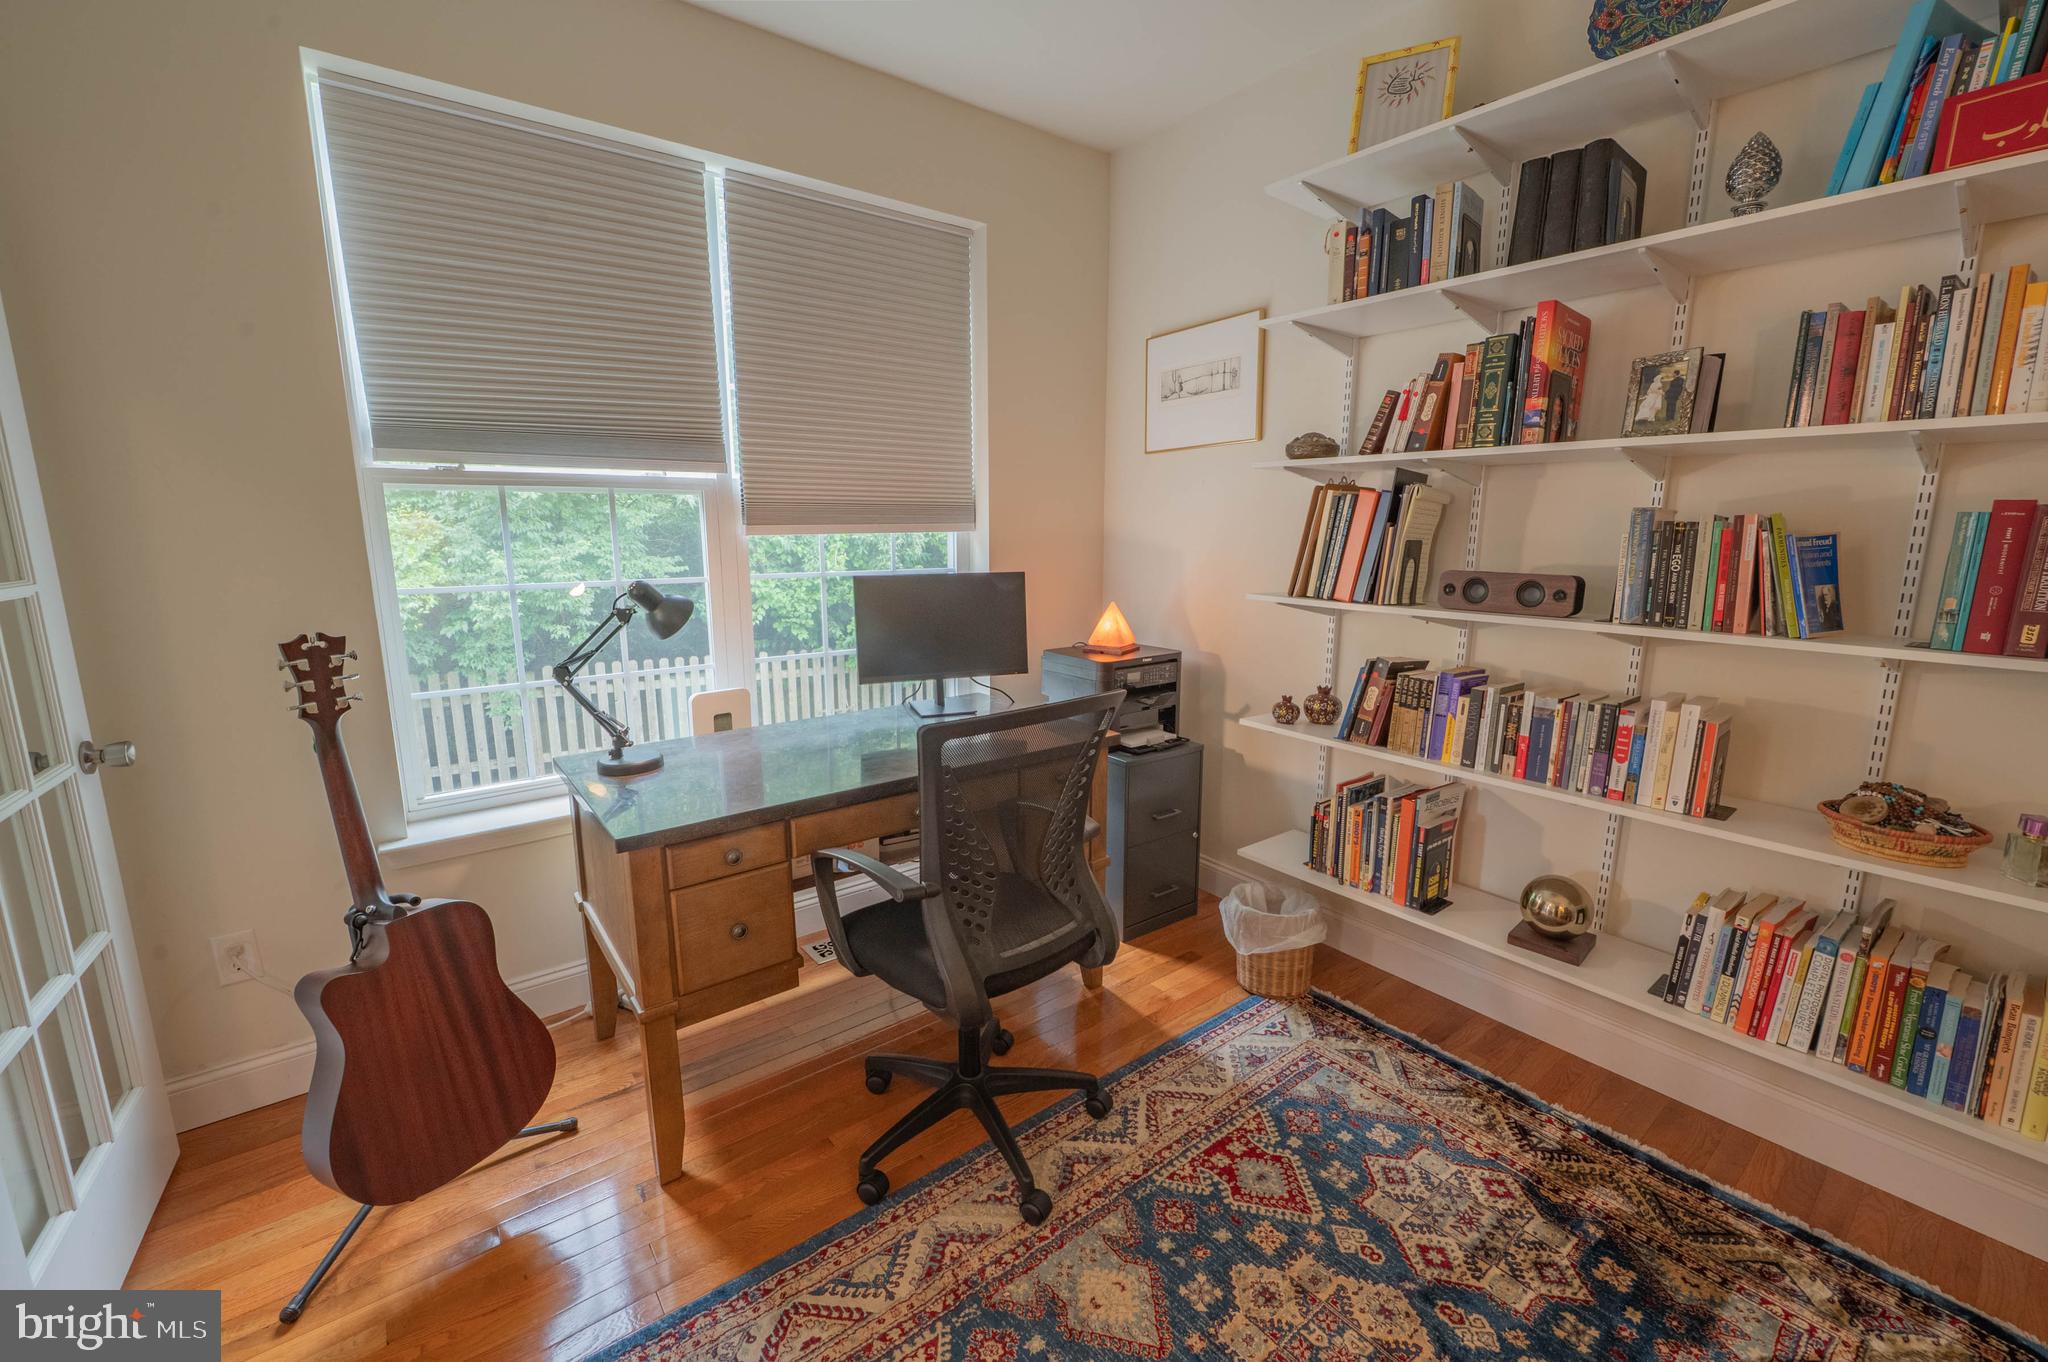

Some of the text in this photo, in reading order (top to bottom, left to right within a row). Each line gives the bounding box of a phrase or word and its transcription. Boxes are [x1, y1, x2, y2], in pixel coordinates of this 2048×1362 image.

[1932, 68, 1949, 96] French
[1939, 294, 1950, 310] RON
[1934, 309, 1948, 345] HUBBARD
[1812, 536, 1832, 546] Freud
[1670, 553, 1681, 571] EGO
[1676, 946, 1685, 960] WIRED
[1670, 969, 1679, 982] STORY
[1792, 954, 1824, 1030] COMPLETE COURSE
[1802, 956, 1833, 1033] DIGITAL PHOTOGRAPHY
[1829, 963, 1849, 1017] THE CHINA STUDY
[1864, 996, 1874, 1009] Slow
[1859, 1010, 1871, 1032] Cooker
[1878, 991, 1896, 1048] SLOW COOKER RECIPES
[1893, 988, 1921, 1077] Fresh Vegetarian Slow Cooker
[1997, 1003, 2020, 1054] Bean Banquets
[1853, 1033, 1866, 1057] Cooking
